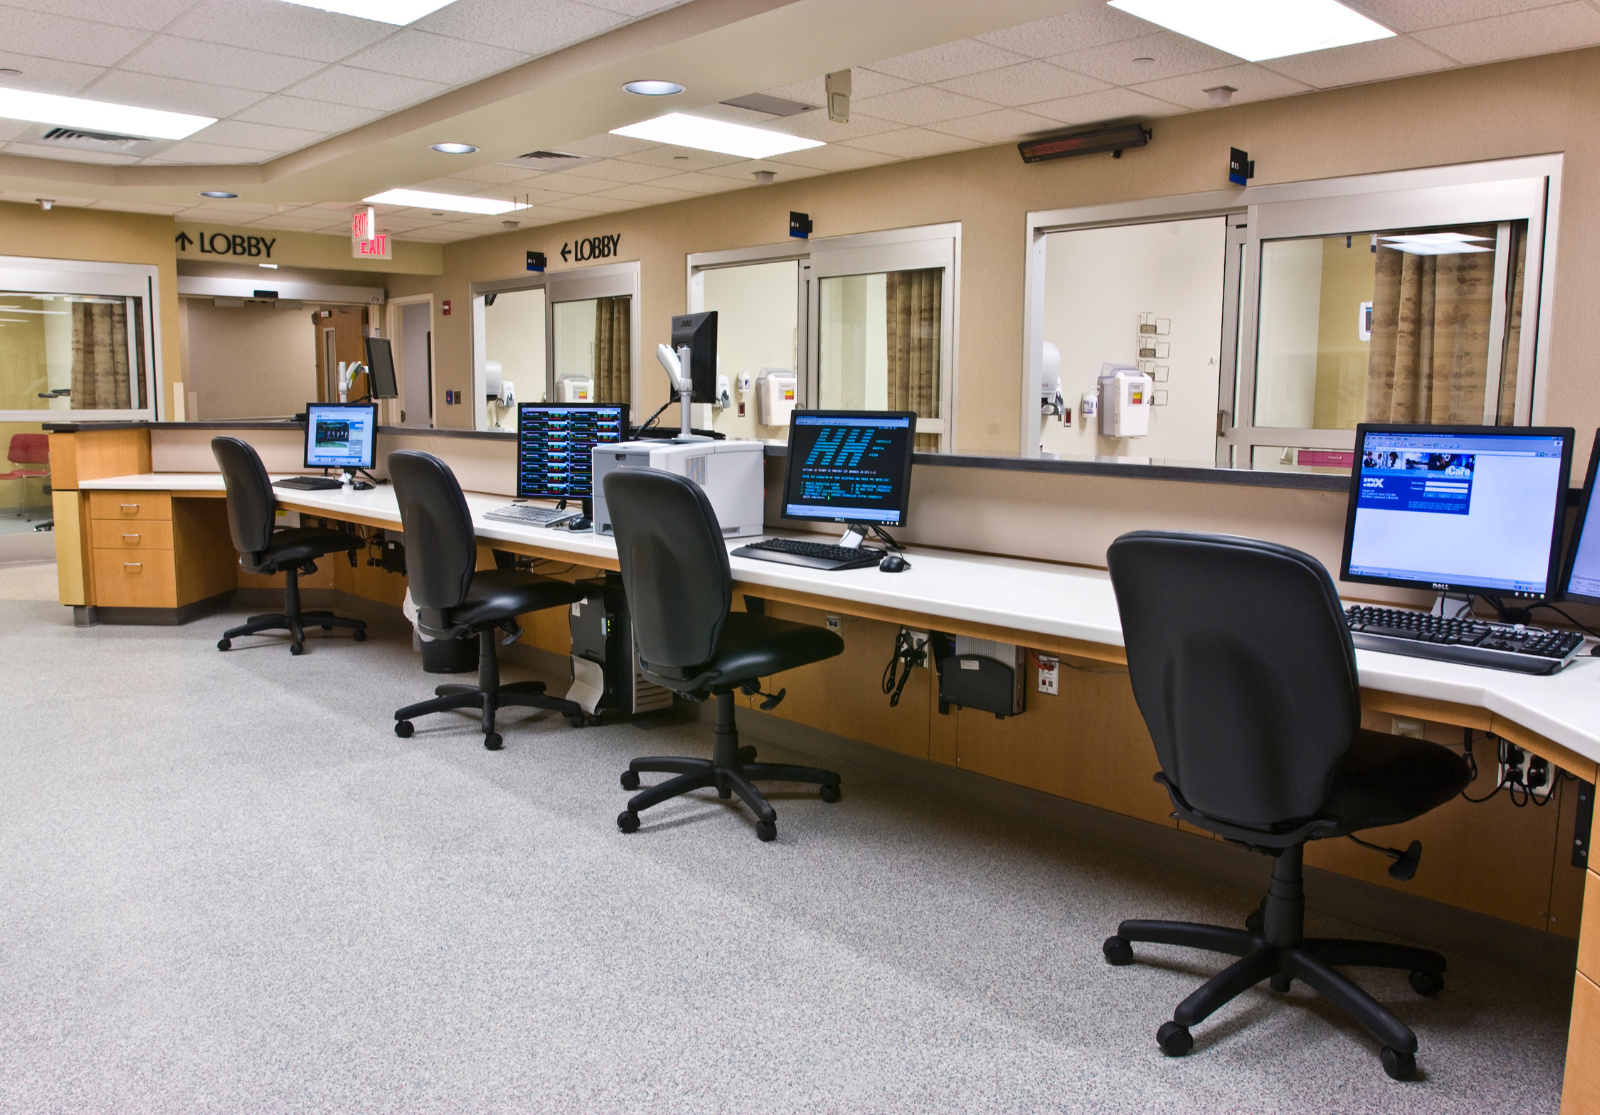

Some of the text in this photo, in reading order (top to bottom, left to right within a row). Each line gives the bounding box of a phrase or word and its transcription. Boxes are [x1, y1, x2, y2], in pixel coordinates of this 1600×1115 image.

[353, 212, 366, 238] EXIT
[199, 232, 276, 258] LOBBY
[360, 233, 387, 255] EXIT
[574, 233, 621, 262] LOBBY
[1445, 465, 1471, 476] iCare
[1362, 477, 1384, 488] IDX
[1432, 583, 1449, 591] DELL
